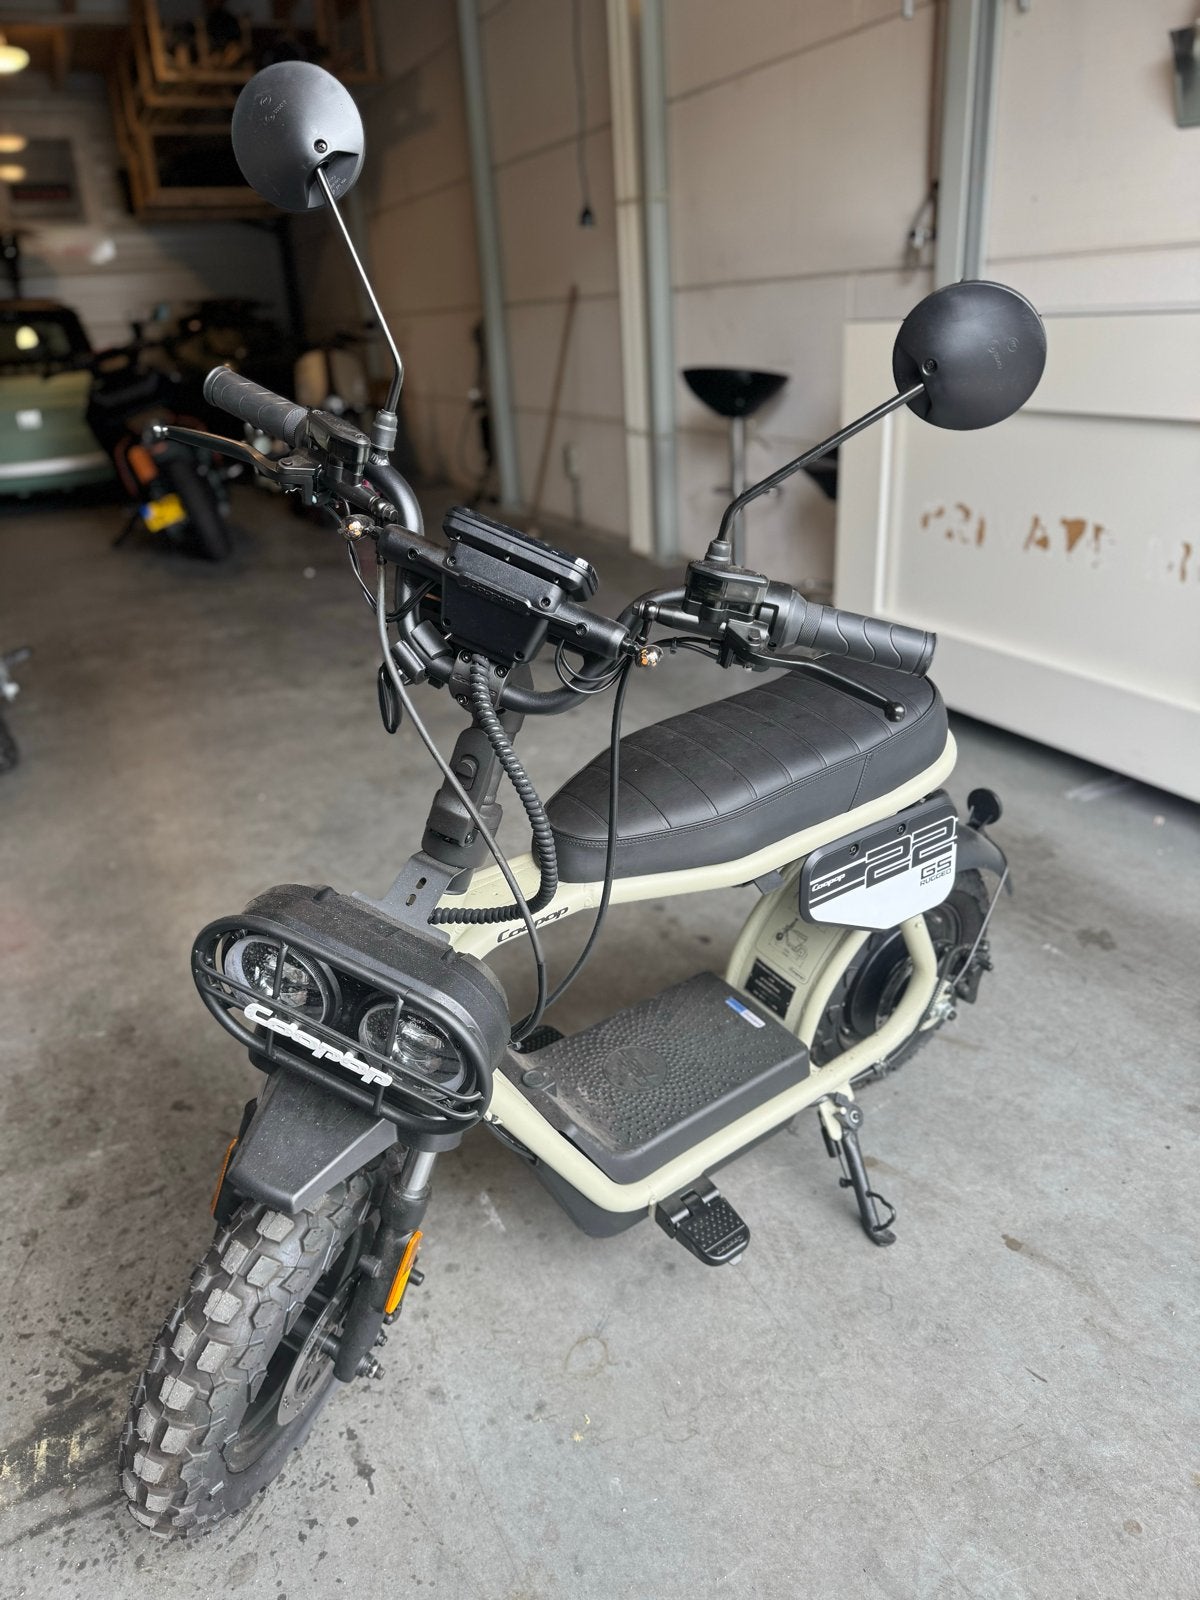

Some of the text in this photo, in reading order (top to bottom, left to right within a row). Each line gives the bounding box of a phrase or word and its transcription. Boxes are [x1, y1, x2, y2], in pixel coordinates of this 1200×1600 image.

[865, 816, 958, 889] 22
[919, 868, 952, 887] RUGGED
[920, 855, 952, 880] GS
